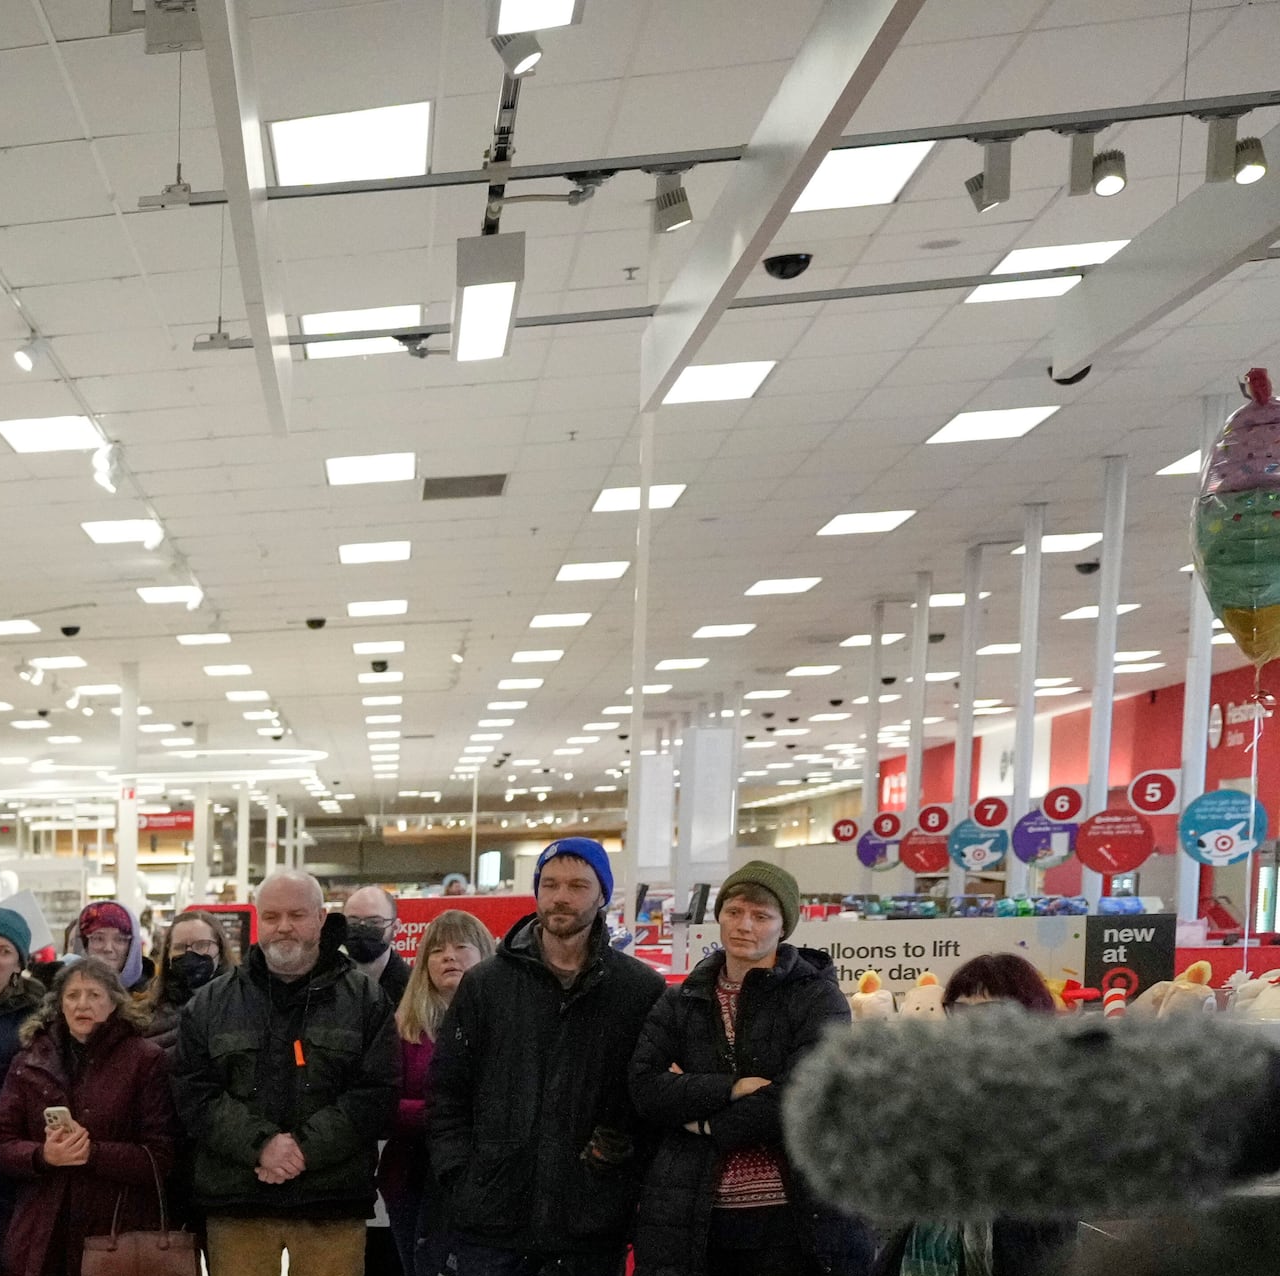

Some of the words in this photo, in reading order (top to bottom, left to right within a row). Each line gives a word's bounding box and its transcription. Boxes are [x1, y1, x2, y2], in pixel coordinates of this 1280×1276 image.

[1144, 783, 1162, 802] 5
[1055, 795, 1070, 812] 6
[928, 813, 940, 827] 8
[983, 804, 998, 820] 7
[838, 825, 853, 837] 10
[882, 819, 893, 832] 9
[1103, 928, 1156, 943] new
[903, 942, 926, 958] to
[932, 940, 961, 958] lift
[1102, 945, 1128, 963] at
